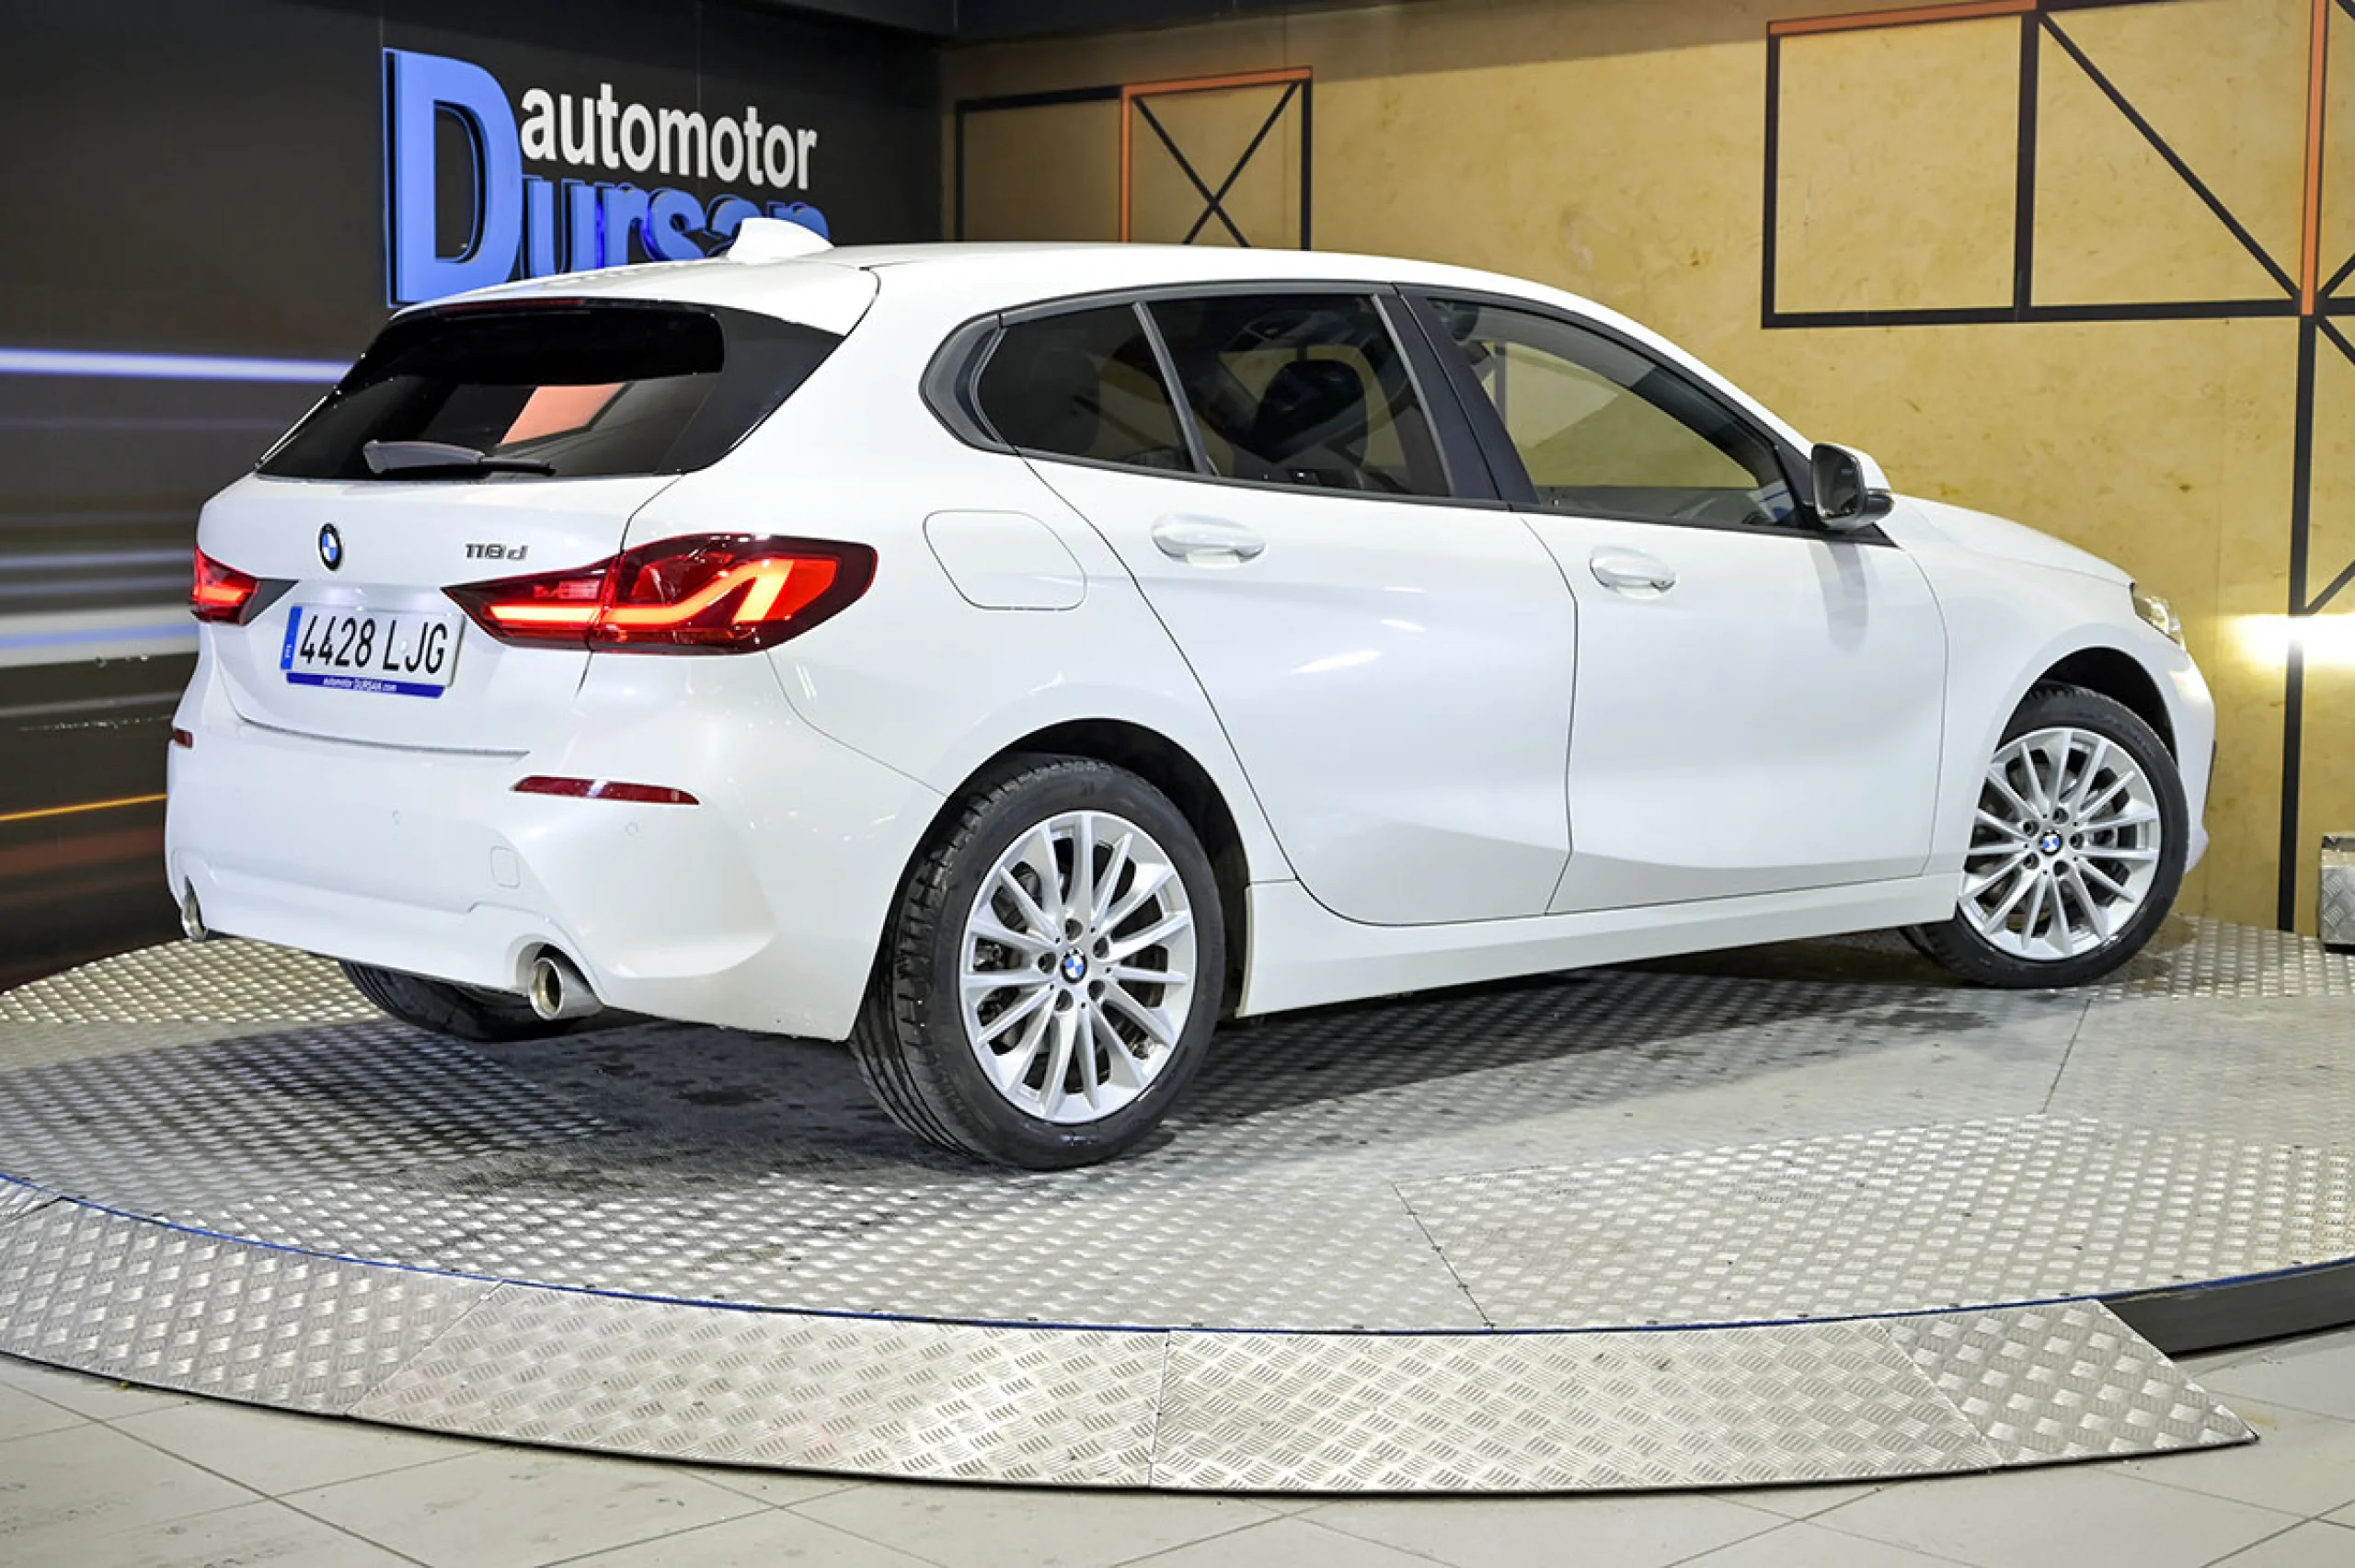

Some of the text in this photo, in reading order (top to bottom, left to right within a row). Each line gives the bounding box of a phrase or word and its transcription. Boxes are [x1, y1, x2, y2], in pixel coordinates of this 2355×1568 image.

[521, 83, 817, 189] automotor
[299, 614, 375, 668] 4428
[382, 619, 448, 674] LJG
